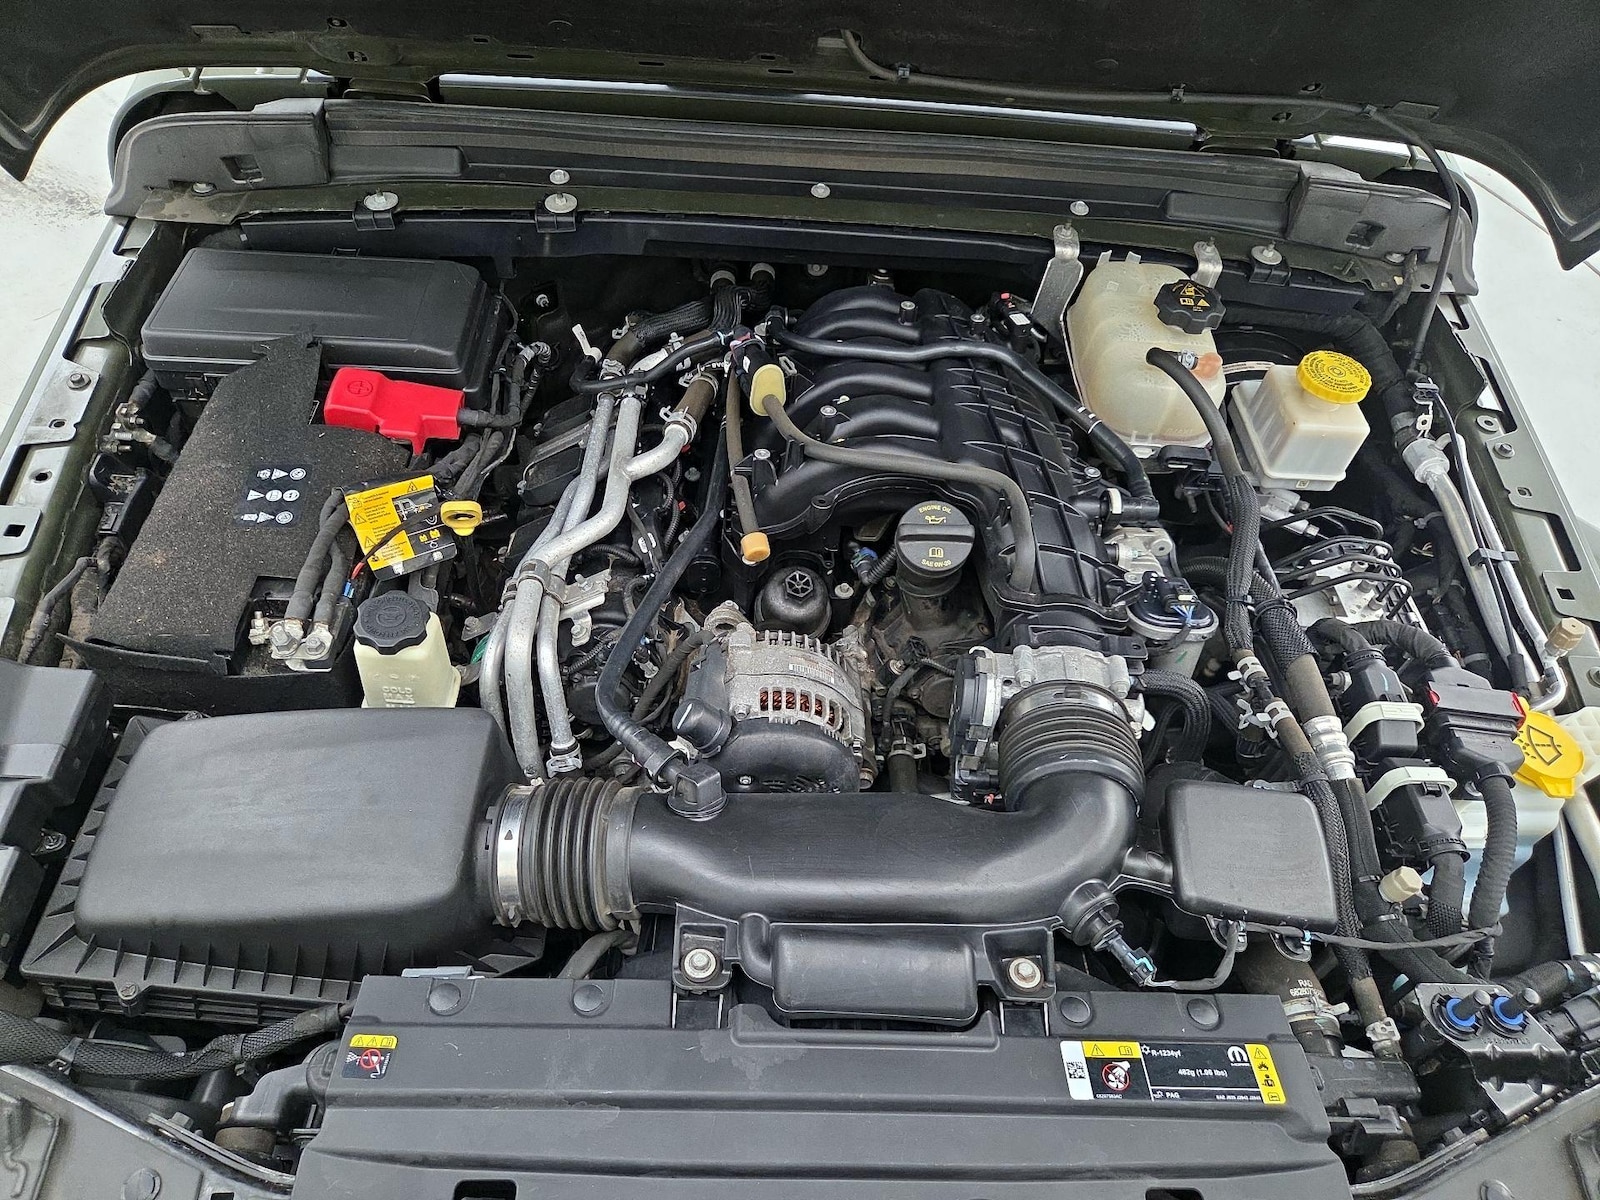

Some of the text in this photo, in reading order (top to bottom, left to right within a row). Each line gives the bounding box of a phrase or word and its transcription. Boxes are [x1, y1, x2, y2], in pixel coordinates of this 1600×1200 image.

[919, 505, 951, 514] ENGINE OIL
[921, 559, 933, 567] SAE
[382, 686, 413, 694] COLD
[383, 693, 413, 701] MAX
[1298, 979, 1313, 987] RAD
[1151, 1049, 1181, 1058] R-1234yf
[1165, 1091, 1181, 1099] PAG
